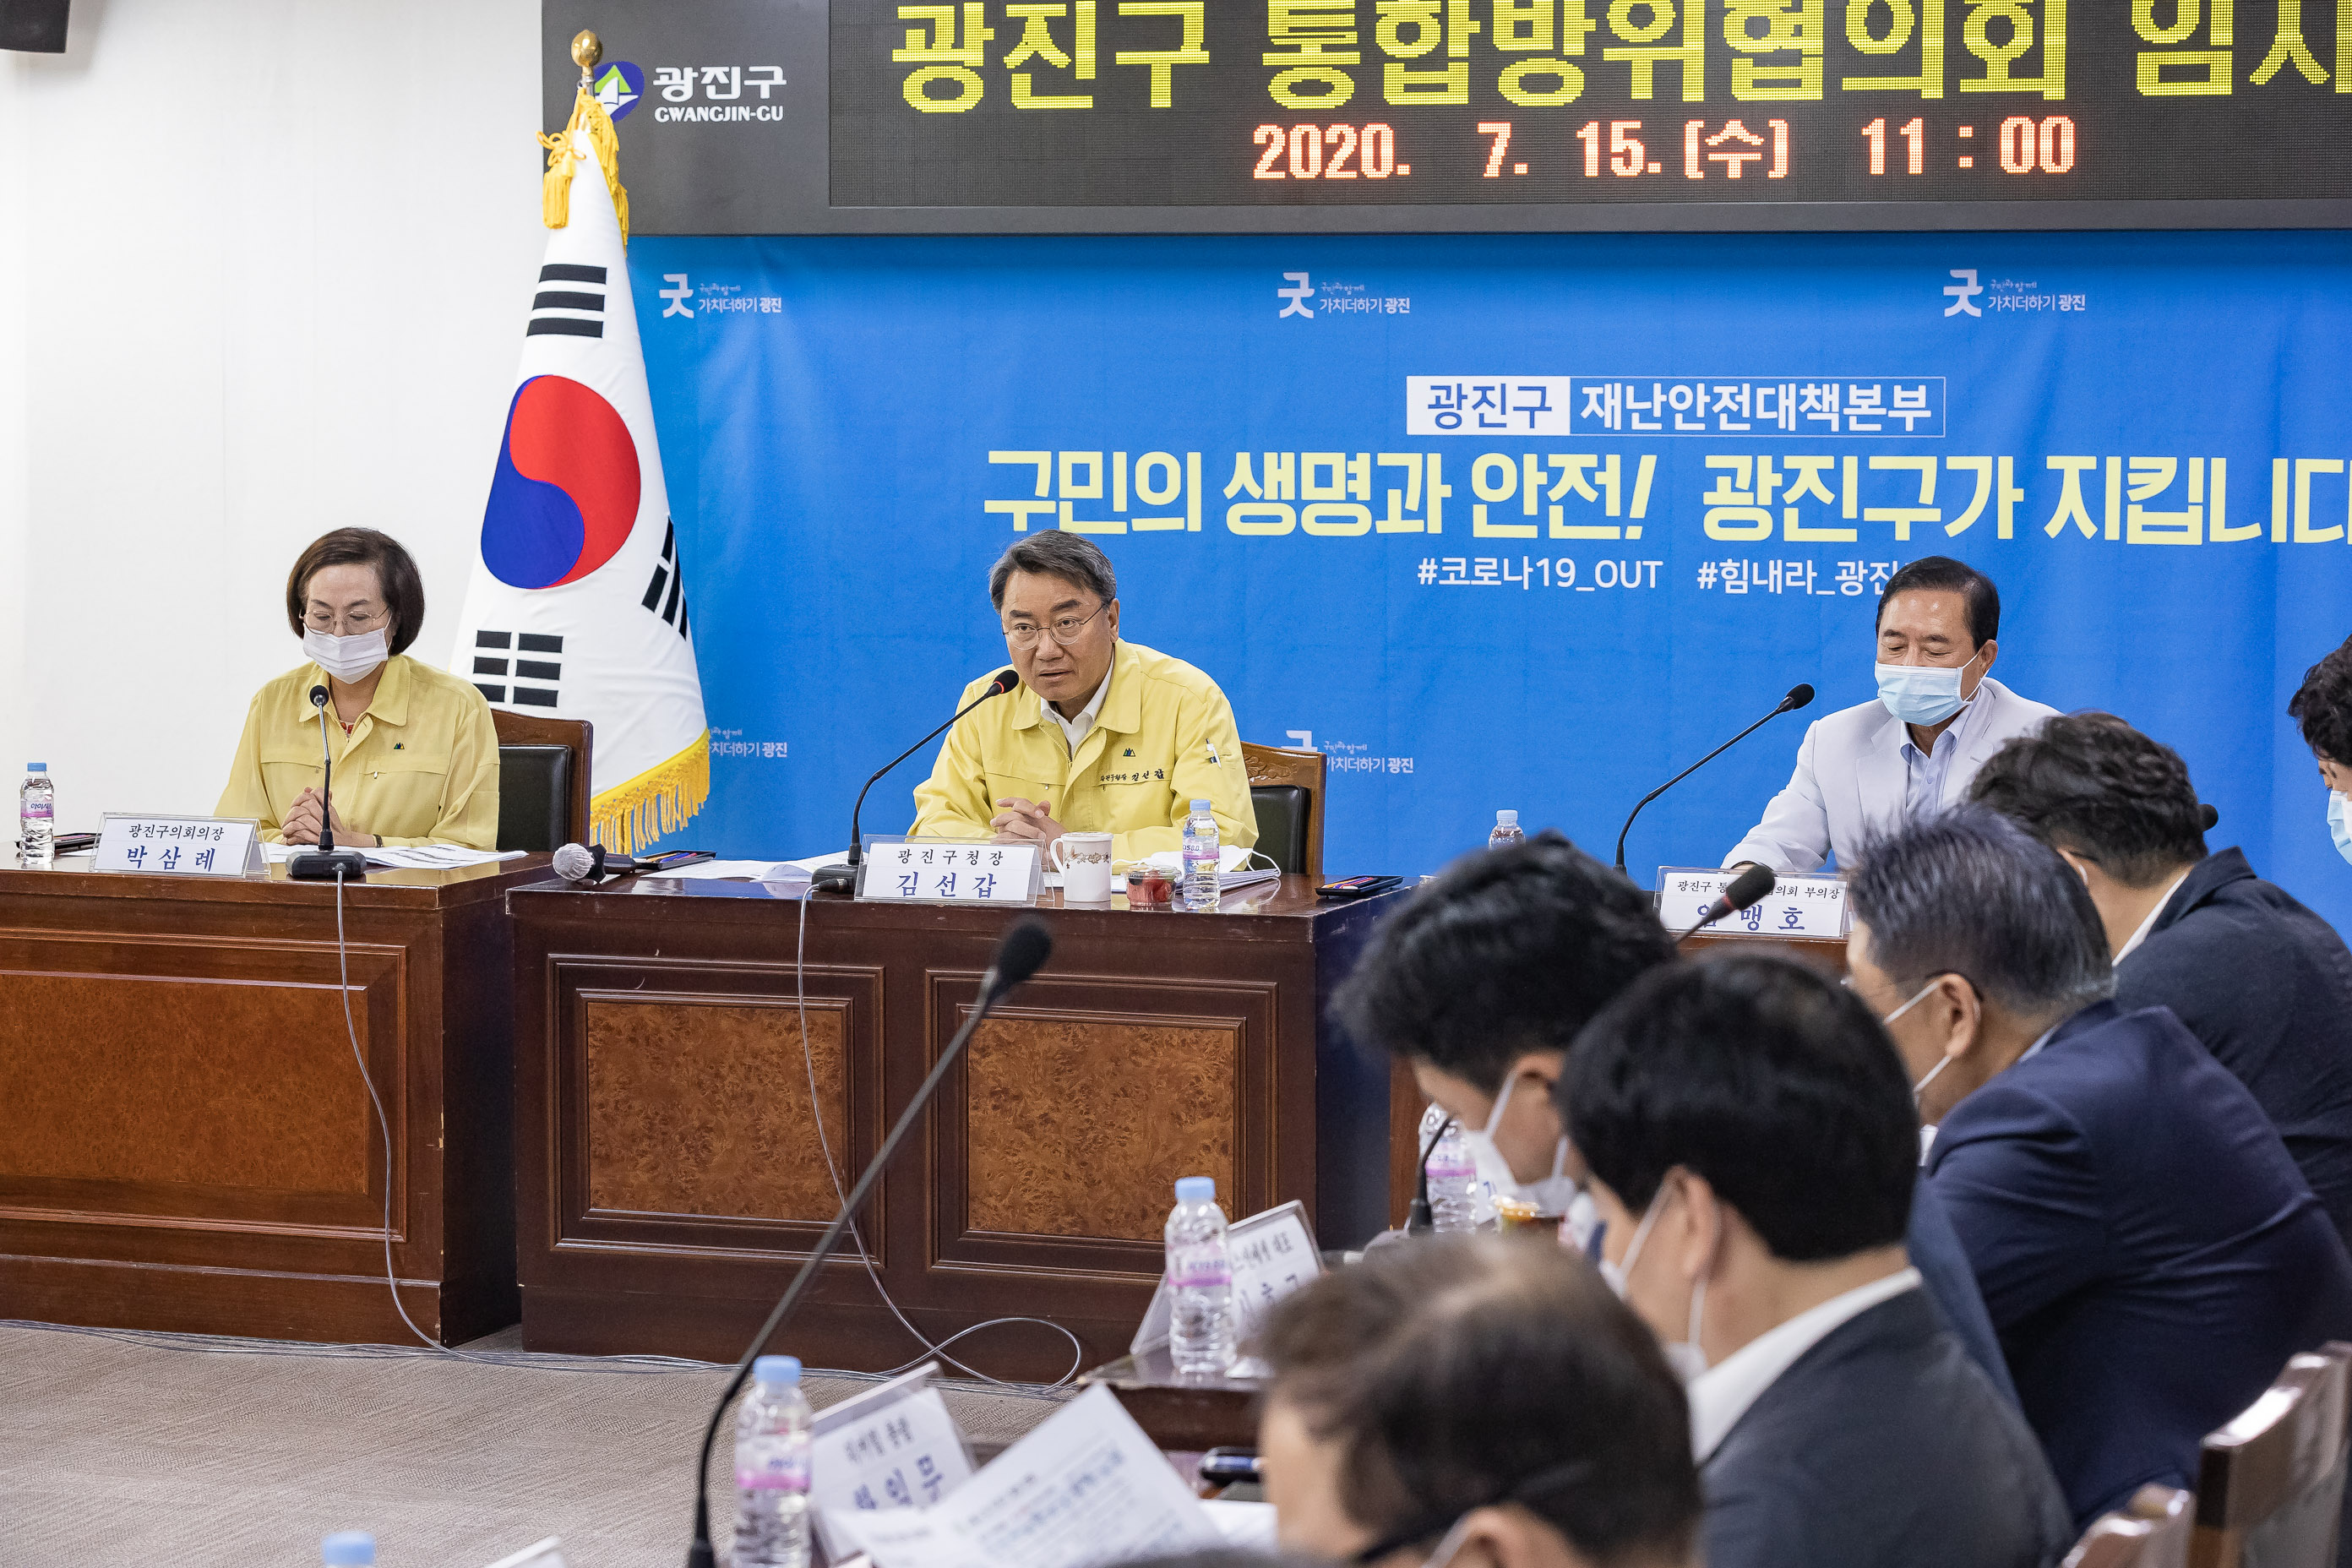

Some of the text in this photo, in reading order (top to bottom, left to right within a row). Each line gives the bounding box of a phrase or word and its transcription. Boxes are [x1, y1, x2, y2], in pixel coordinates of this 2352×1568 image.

[892, 0, 1210, 113] 광진구
[1262, 0, 2066, 109] 통합방위협의회
[653, 66, 787, 100] 광진구
[655, 106, 784, 122] GWANGJIN-GU
[1253, 123, 1411, 178] 2020.
[1477, 122, 1528, 177] 7.
[1576, 121, 1662, 177] 15.
[699, 297, 782, 313] 가치더하기 광진
[1320, 297, 1410, 314] 가치더하기 광진
[1988, 294, 2086, 312] 가치더하기 광진
[1427, 383, 1932, 433] 광진구 재난안전대책본부
[983, 450, 1201, 535] 구민의
[1223, 451, 1451, 536] 생명과
[1472, 453, 1657, 541] 안전!
[1702, 455, 2024, 542] 광진구가
[1418, 556, 1909, 596] #코로나19_OUT #힘내라_광진
[709, 742, 787, 758] 치더하기 광진
[1387, 757, 1414, 774] 광진
[128, 824, 224, 841] 광진구의회의장
[1677, 880, 1712, 894] 광진구
[1805, 886, 1840, 900] 부의장
